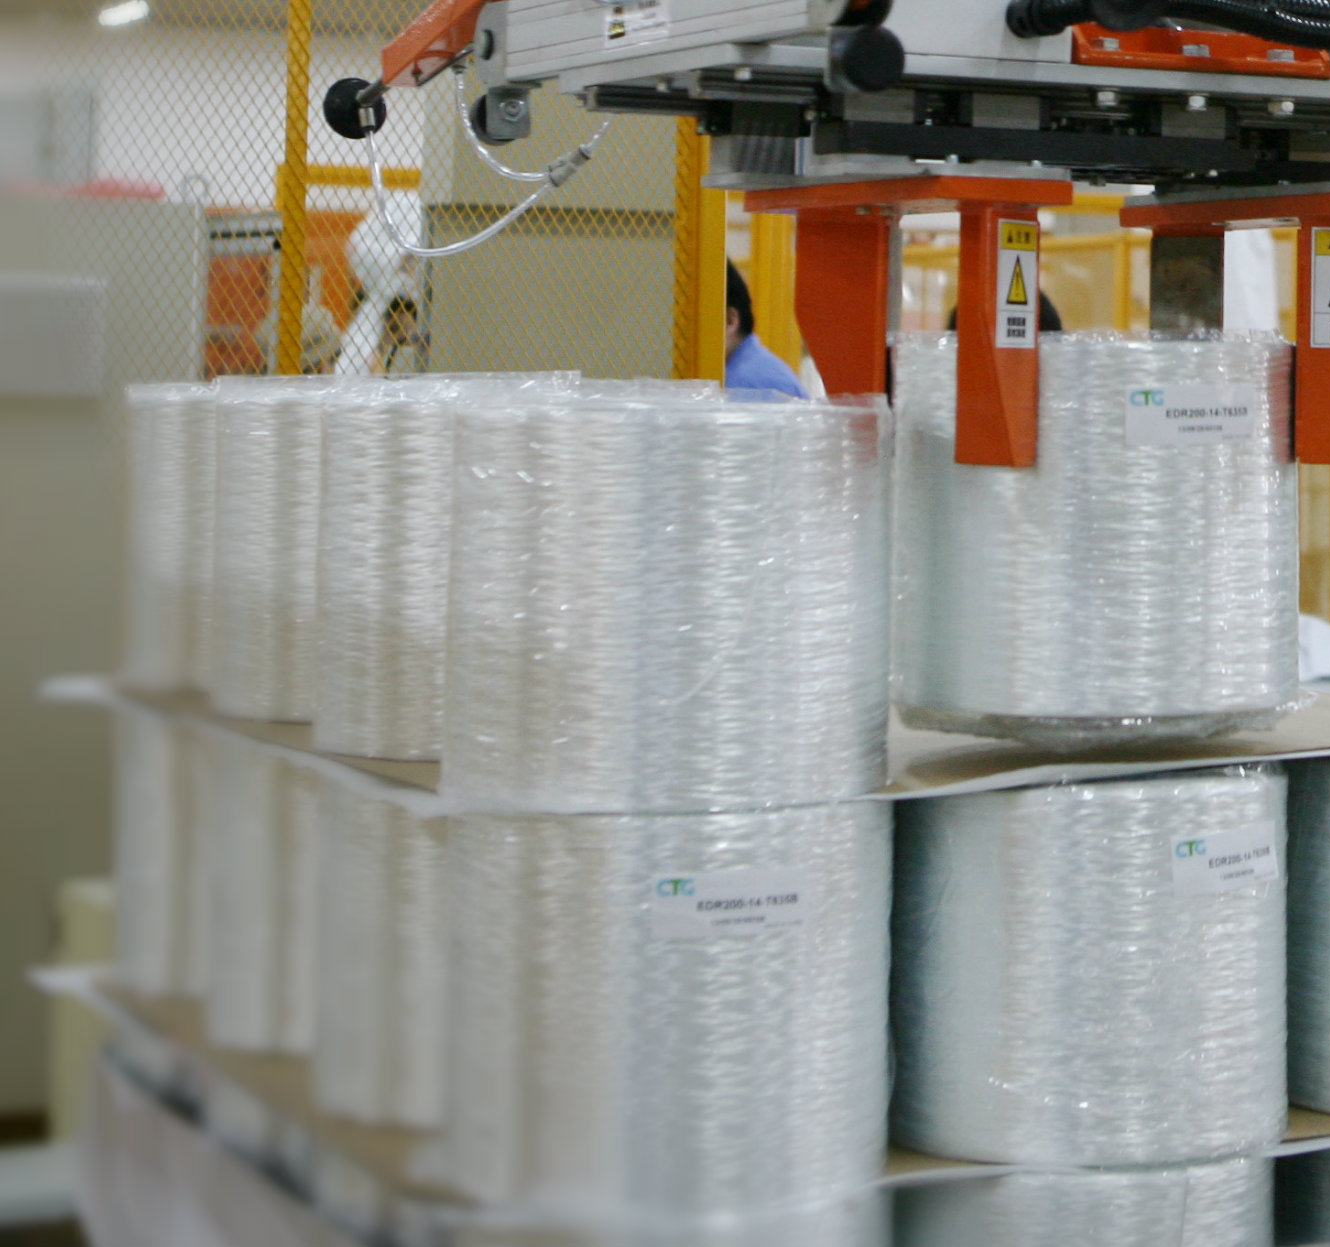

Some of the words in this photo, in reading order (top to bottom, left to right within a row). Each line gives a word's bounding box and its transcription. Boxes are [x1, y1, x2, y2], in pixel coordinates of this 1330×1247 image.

[1130, 389, 1165, 407] CTG
[1175, 838, 1208, 858] CTG
[656, 878, 696, 897] CTG
